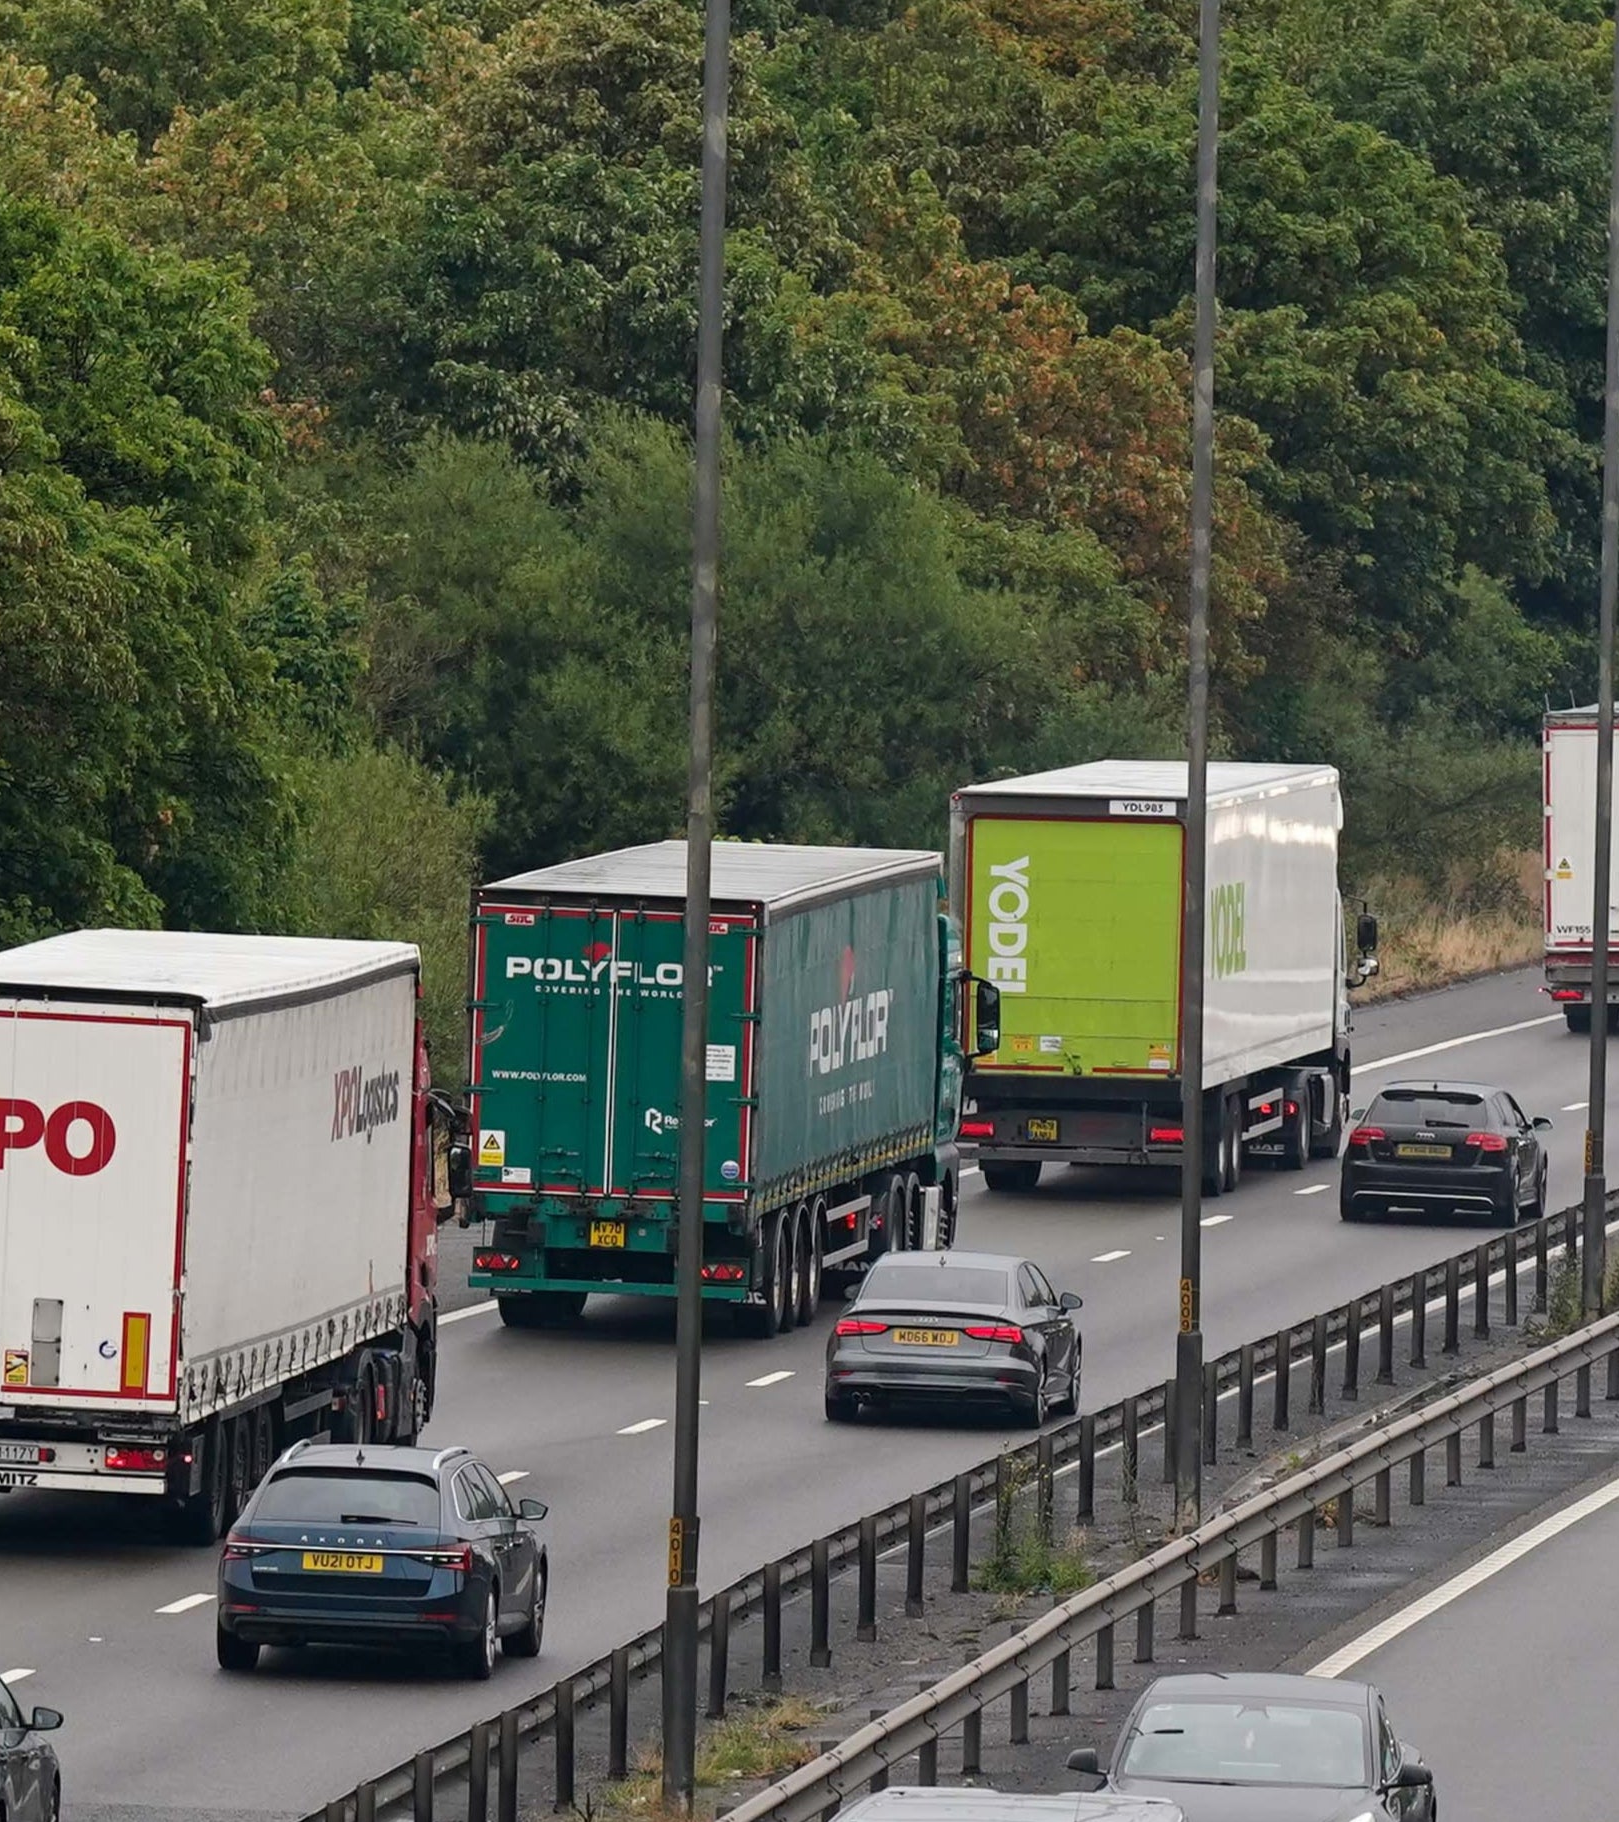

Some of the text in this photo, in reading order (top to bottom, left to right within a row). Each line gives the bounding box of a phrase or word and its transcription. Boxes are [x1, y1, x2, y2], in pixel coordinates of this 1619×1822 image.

[1122, 802, 1164, 814] YDL983
[1210, 881, 1247, 981] YODEL
[1556, 925, 1592, 934] WF155
[1180, 1281, 1191, 1331] 4009
[312, 1553, 374, 1570] VU21 OTJ
[670, 1521, 681, 1584] 4010
